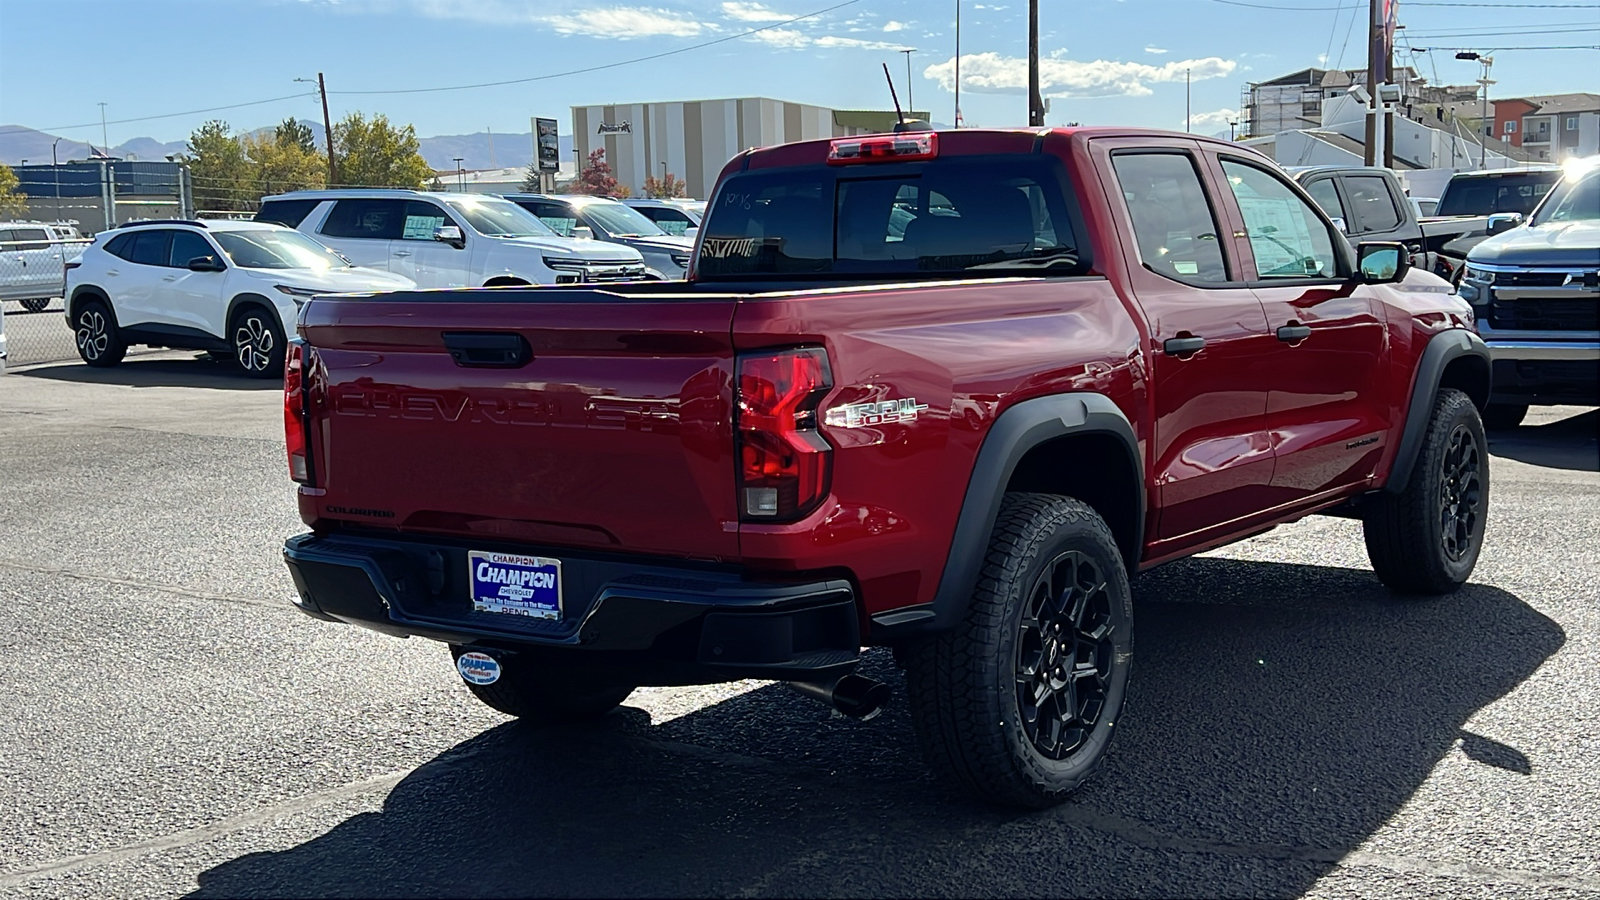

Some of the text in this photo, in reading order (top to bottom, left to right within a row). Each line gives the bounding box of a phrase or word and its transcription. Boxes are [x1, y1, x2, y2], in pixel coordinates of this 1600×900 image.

[492, 554, 535, 566] CHAMPION
[477, 562, 555, 589] CHAMPION
[500, 588, 532, 597] CHEVROLET
